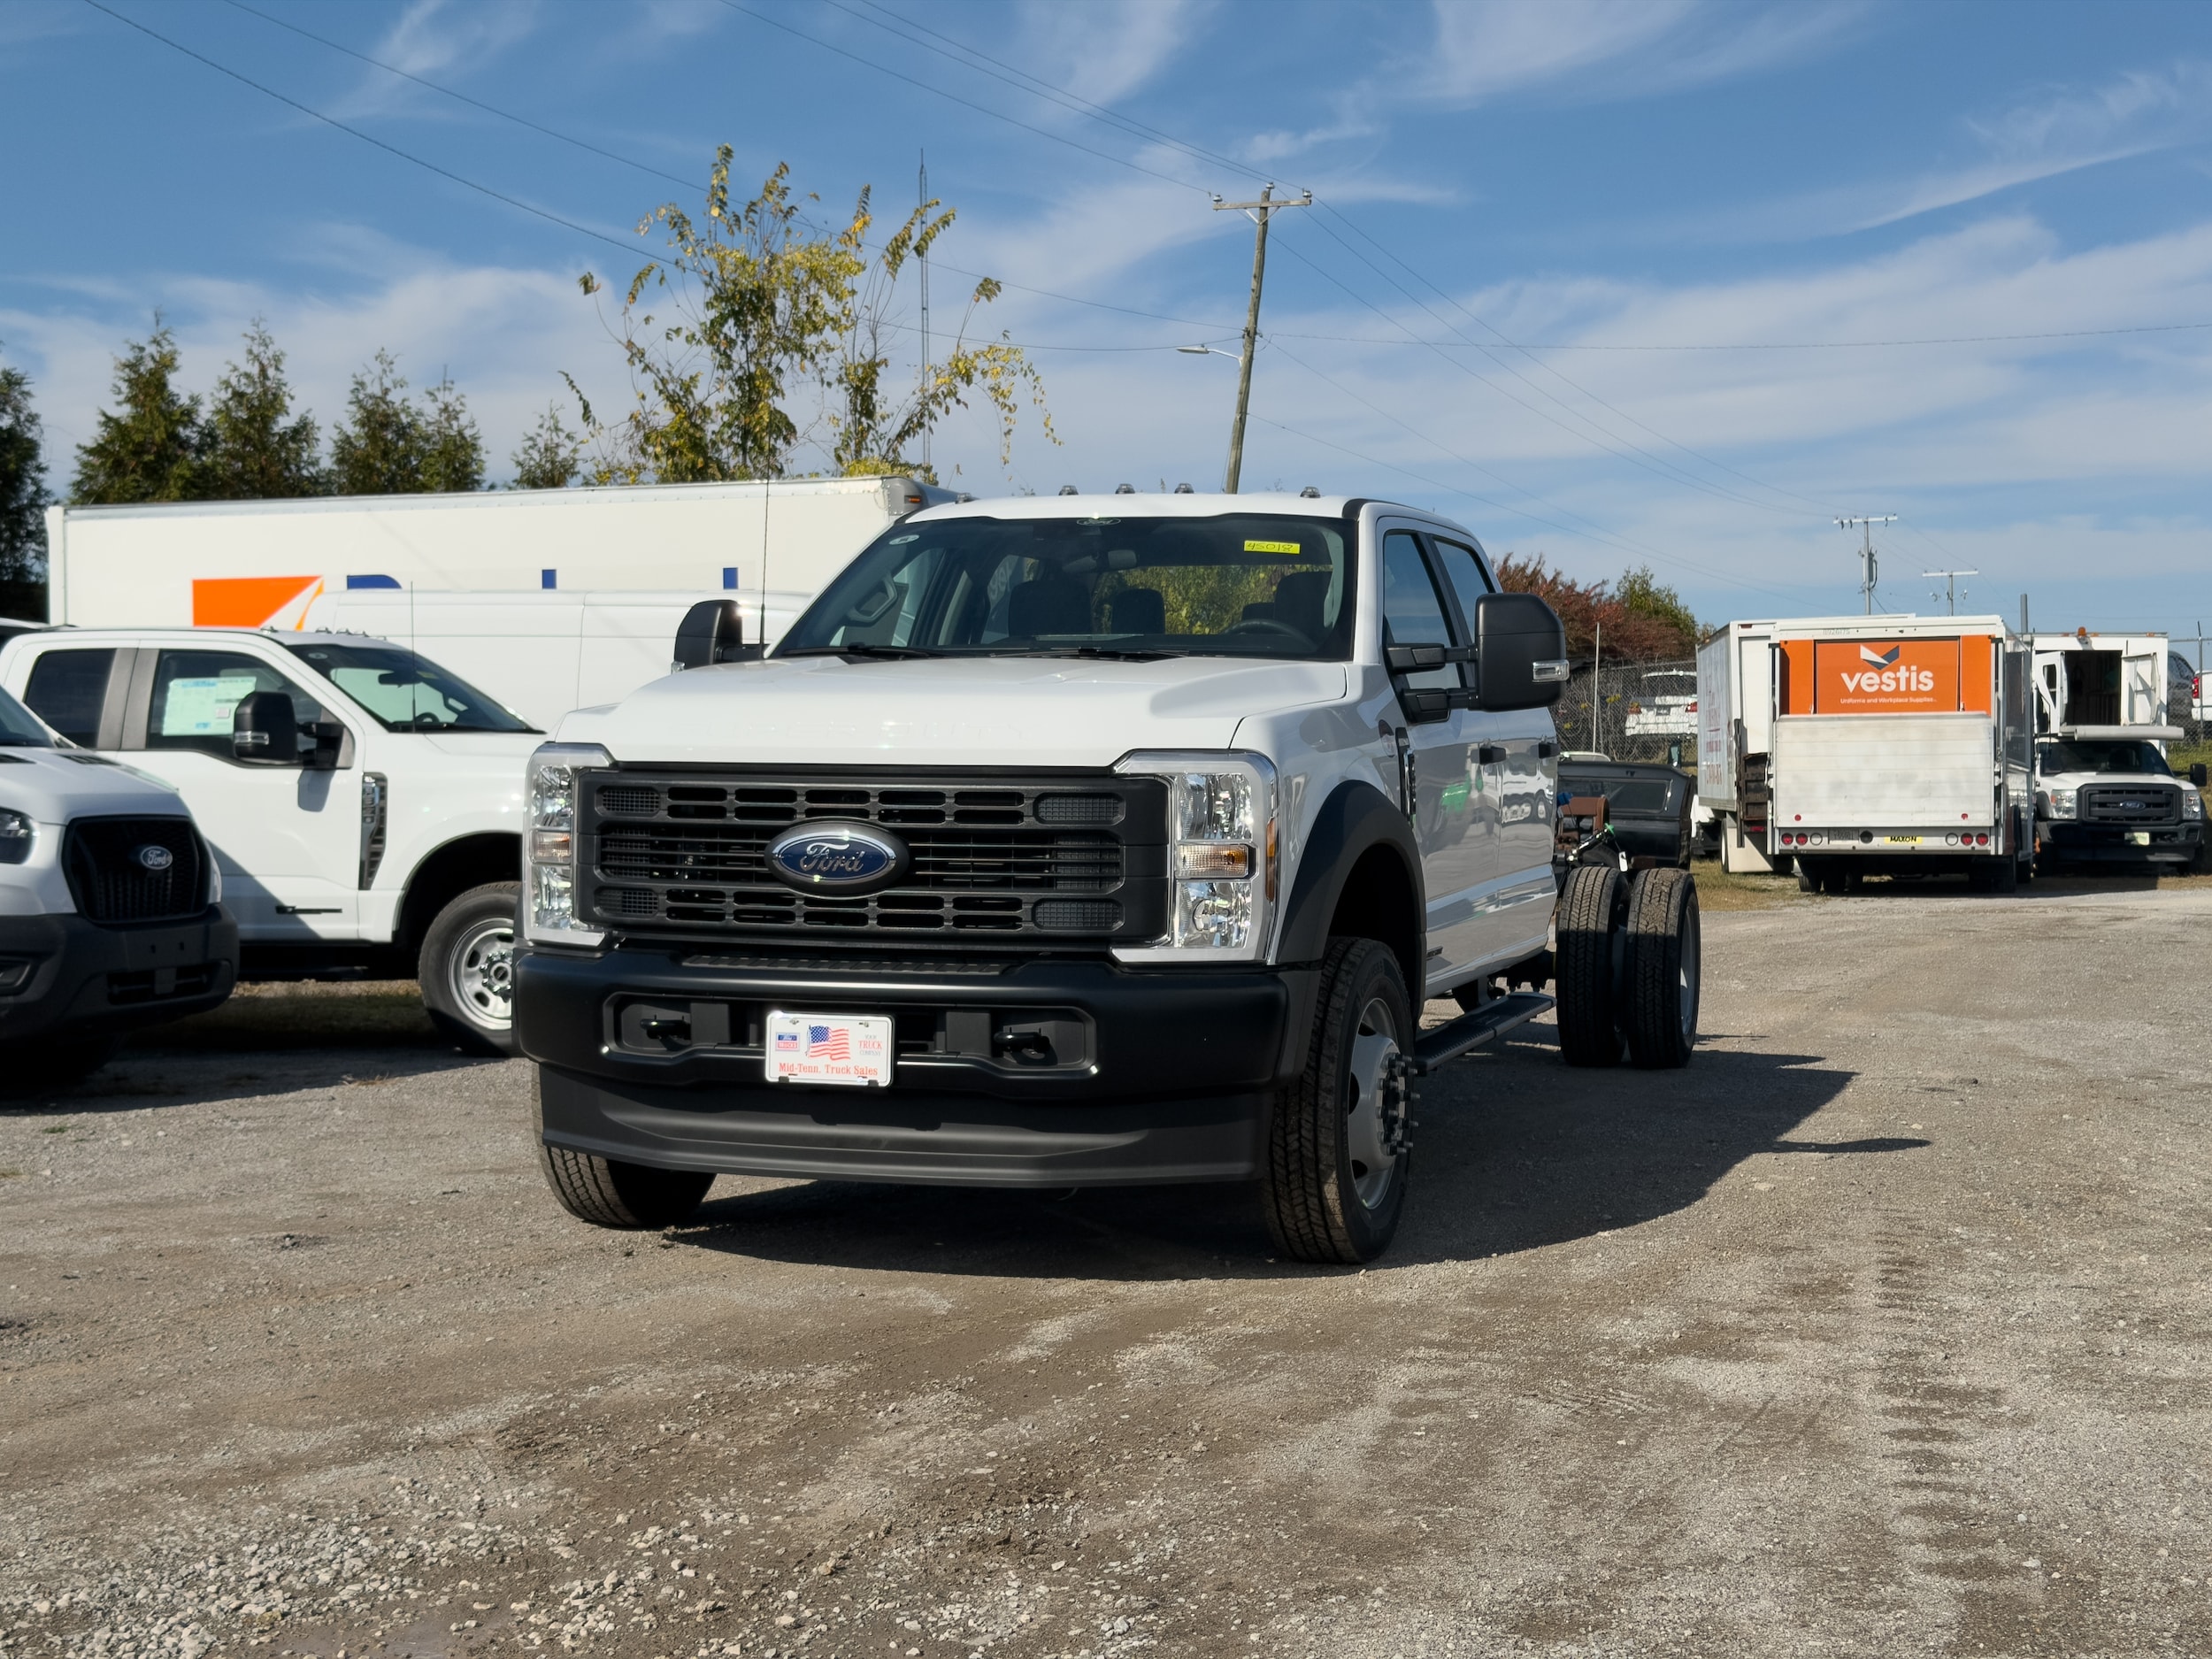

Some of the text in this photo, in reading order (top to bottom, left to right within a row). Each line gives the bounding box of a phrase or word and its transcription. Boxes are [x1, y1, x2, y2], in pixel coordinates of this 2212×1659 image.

[1840, 665, 1934, 694] vestis
[148, 849, 166, 865] Ford
[800, 841, 865, 872] Ford
[858, 1040, 882, 1049] TRUCK
[779, 1063, 878, 1076] Mid-Tenn. Truck Sales
